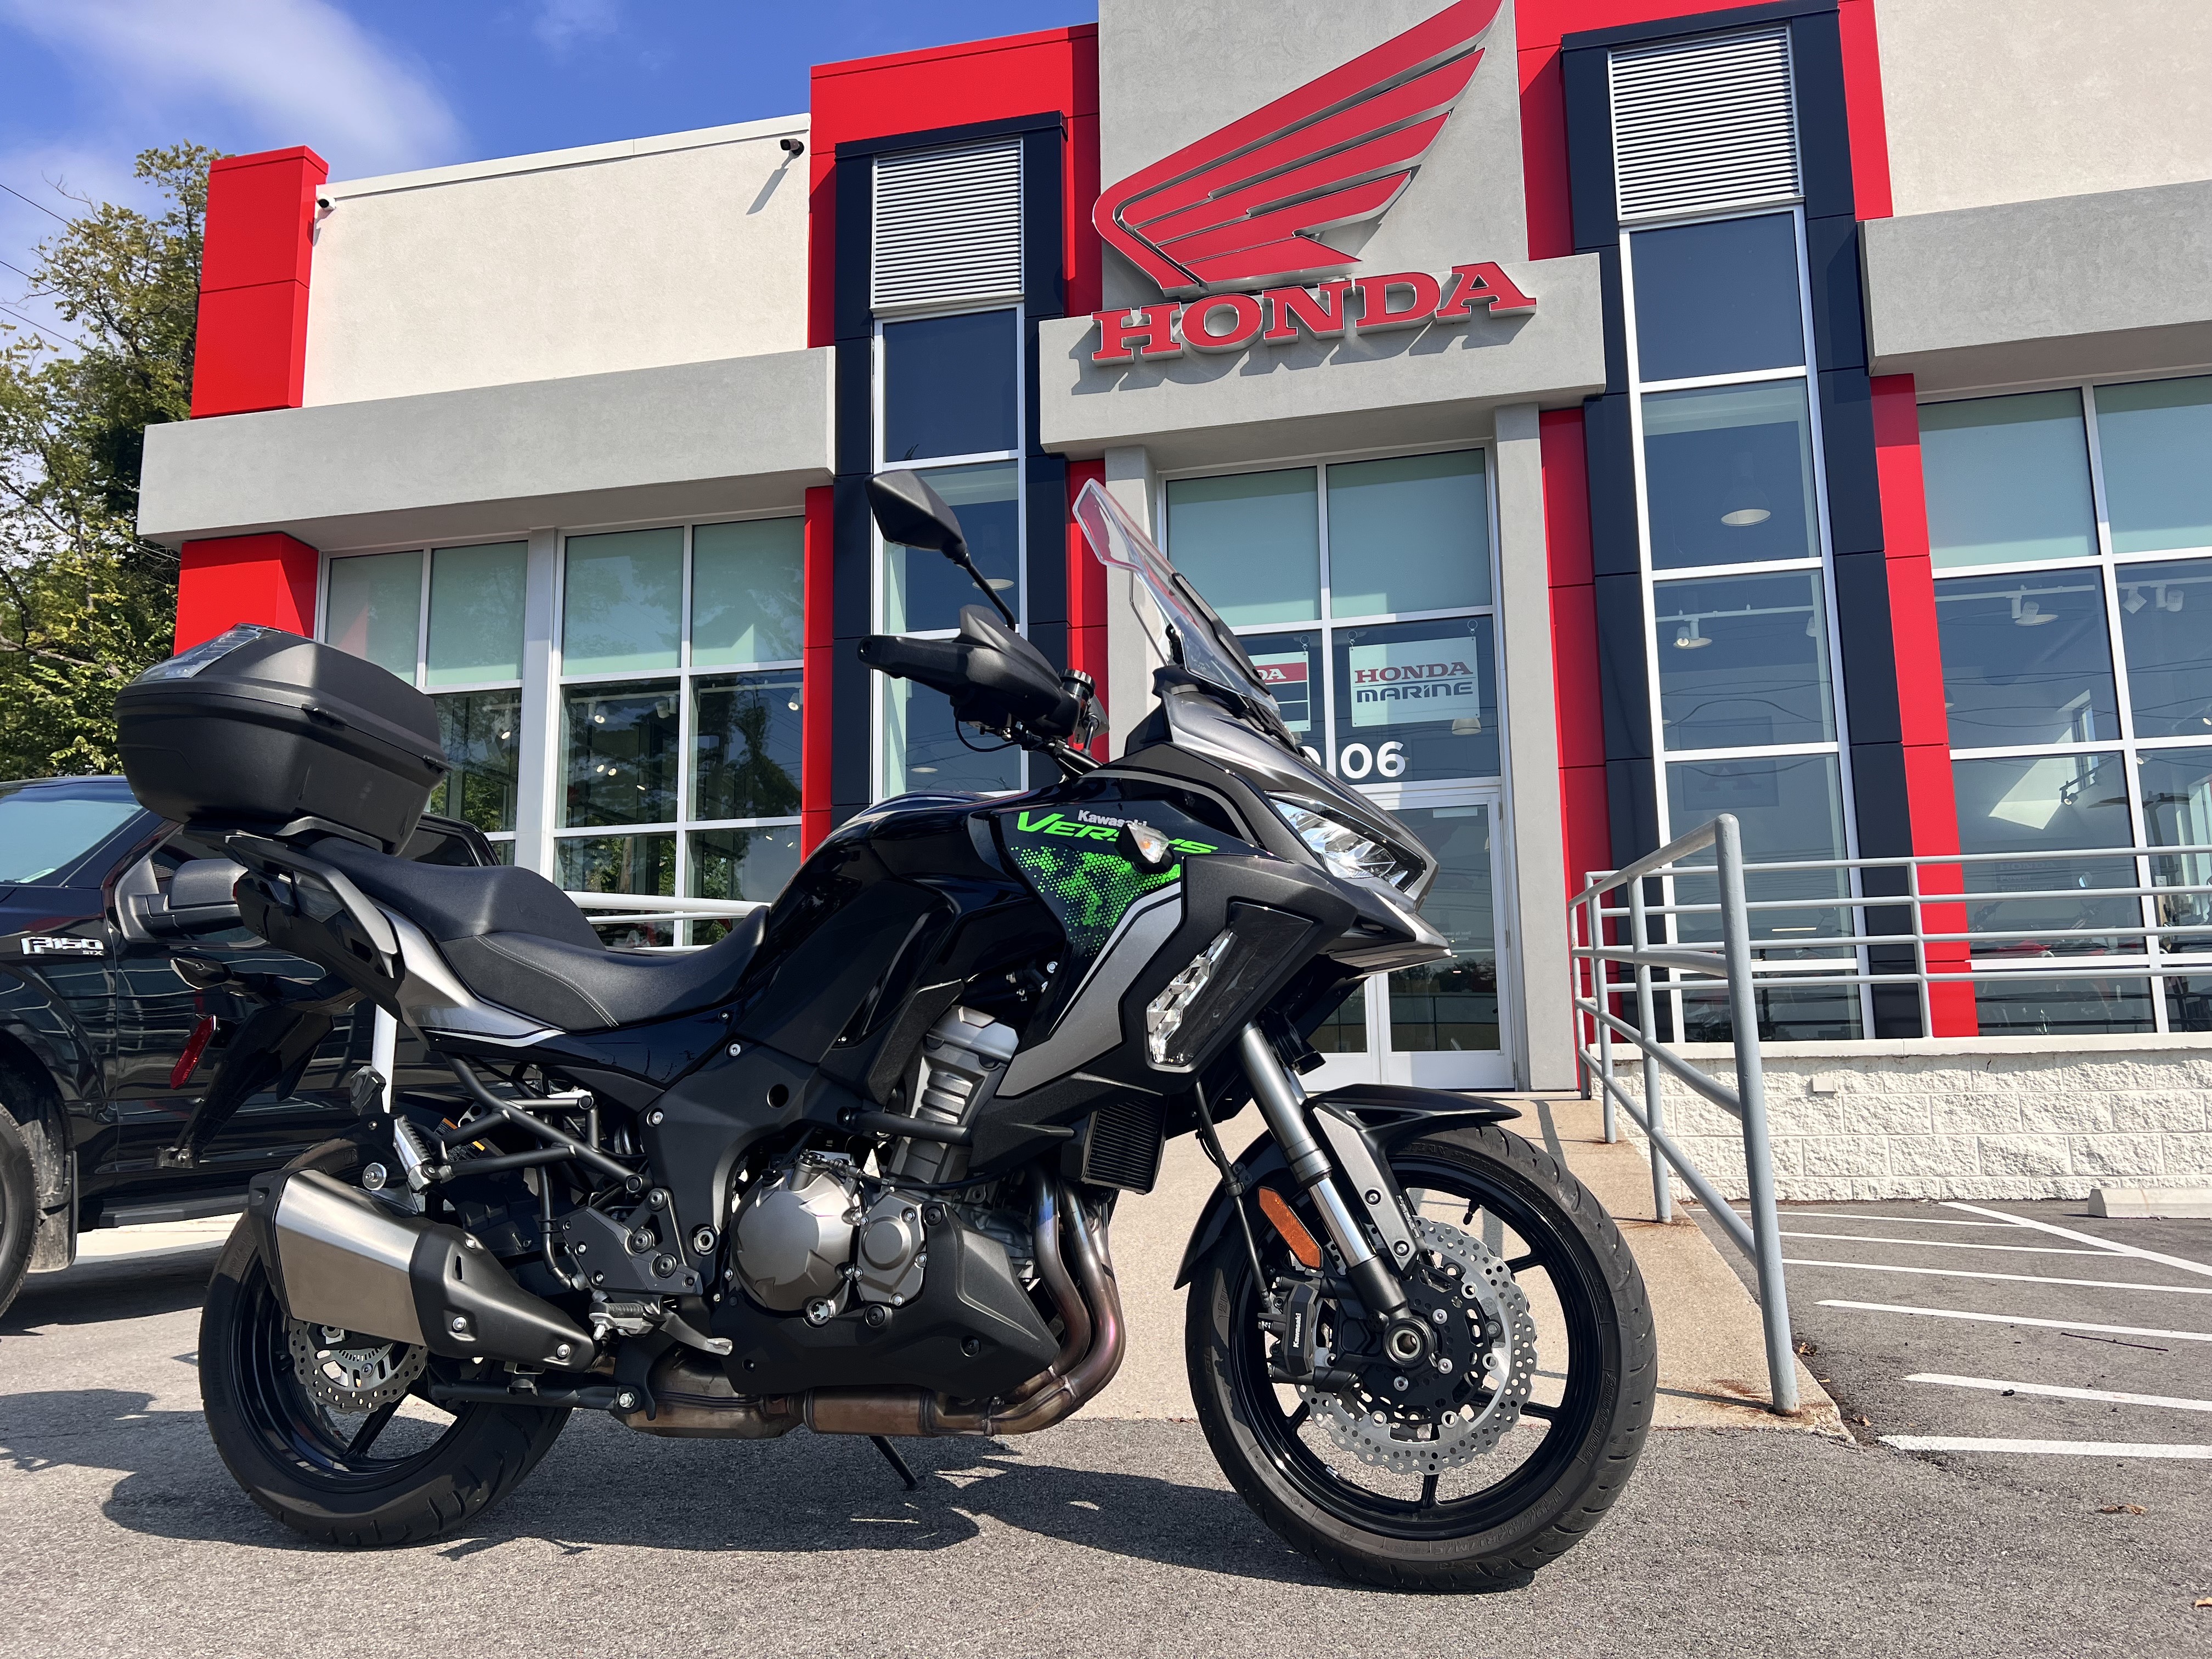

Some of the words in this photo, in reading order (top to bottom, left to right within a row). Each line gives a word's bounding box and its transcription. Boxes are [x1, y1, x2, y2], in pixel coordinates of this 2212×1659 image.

[1092, 262, 1537, 365] HONDA
[1355, 662, 1474, 684] HONDA
[1357, 681, 1474, 703] MARINE
[1017, 811, 1218, 854] VERS
[1293, 1312, 1302, 1348] Kawasaki
